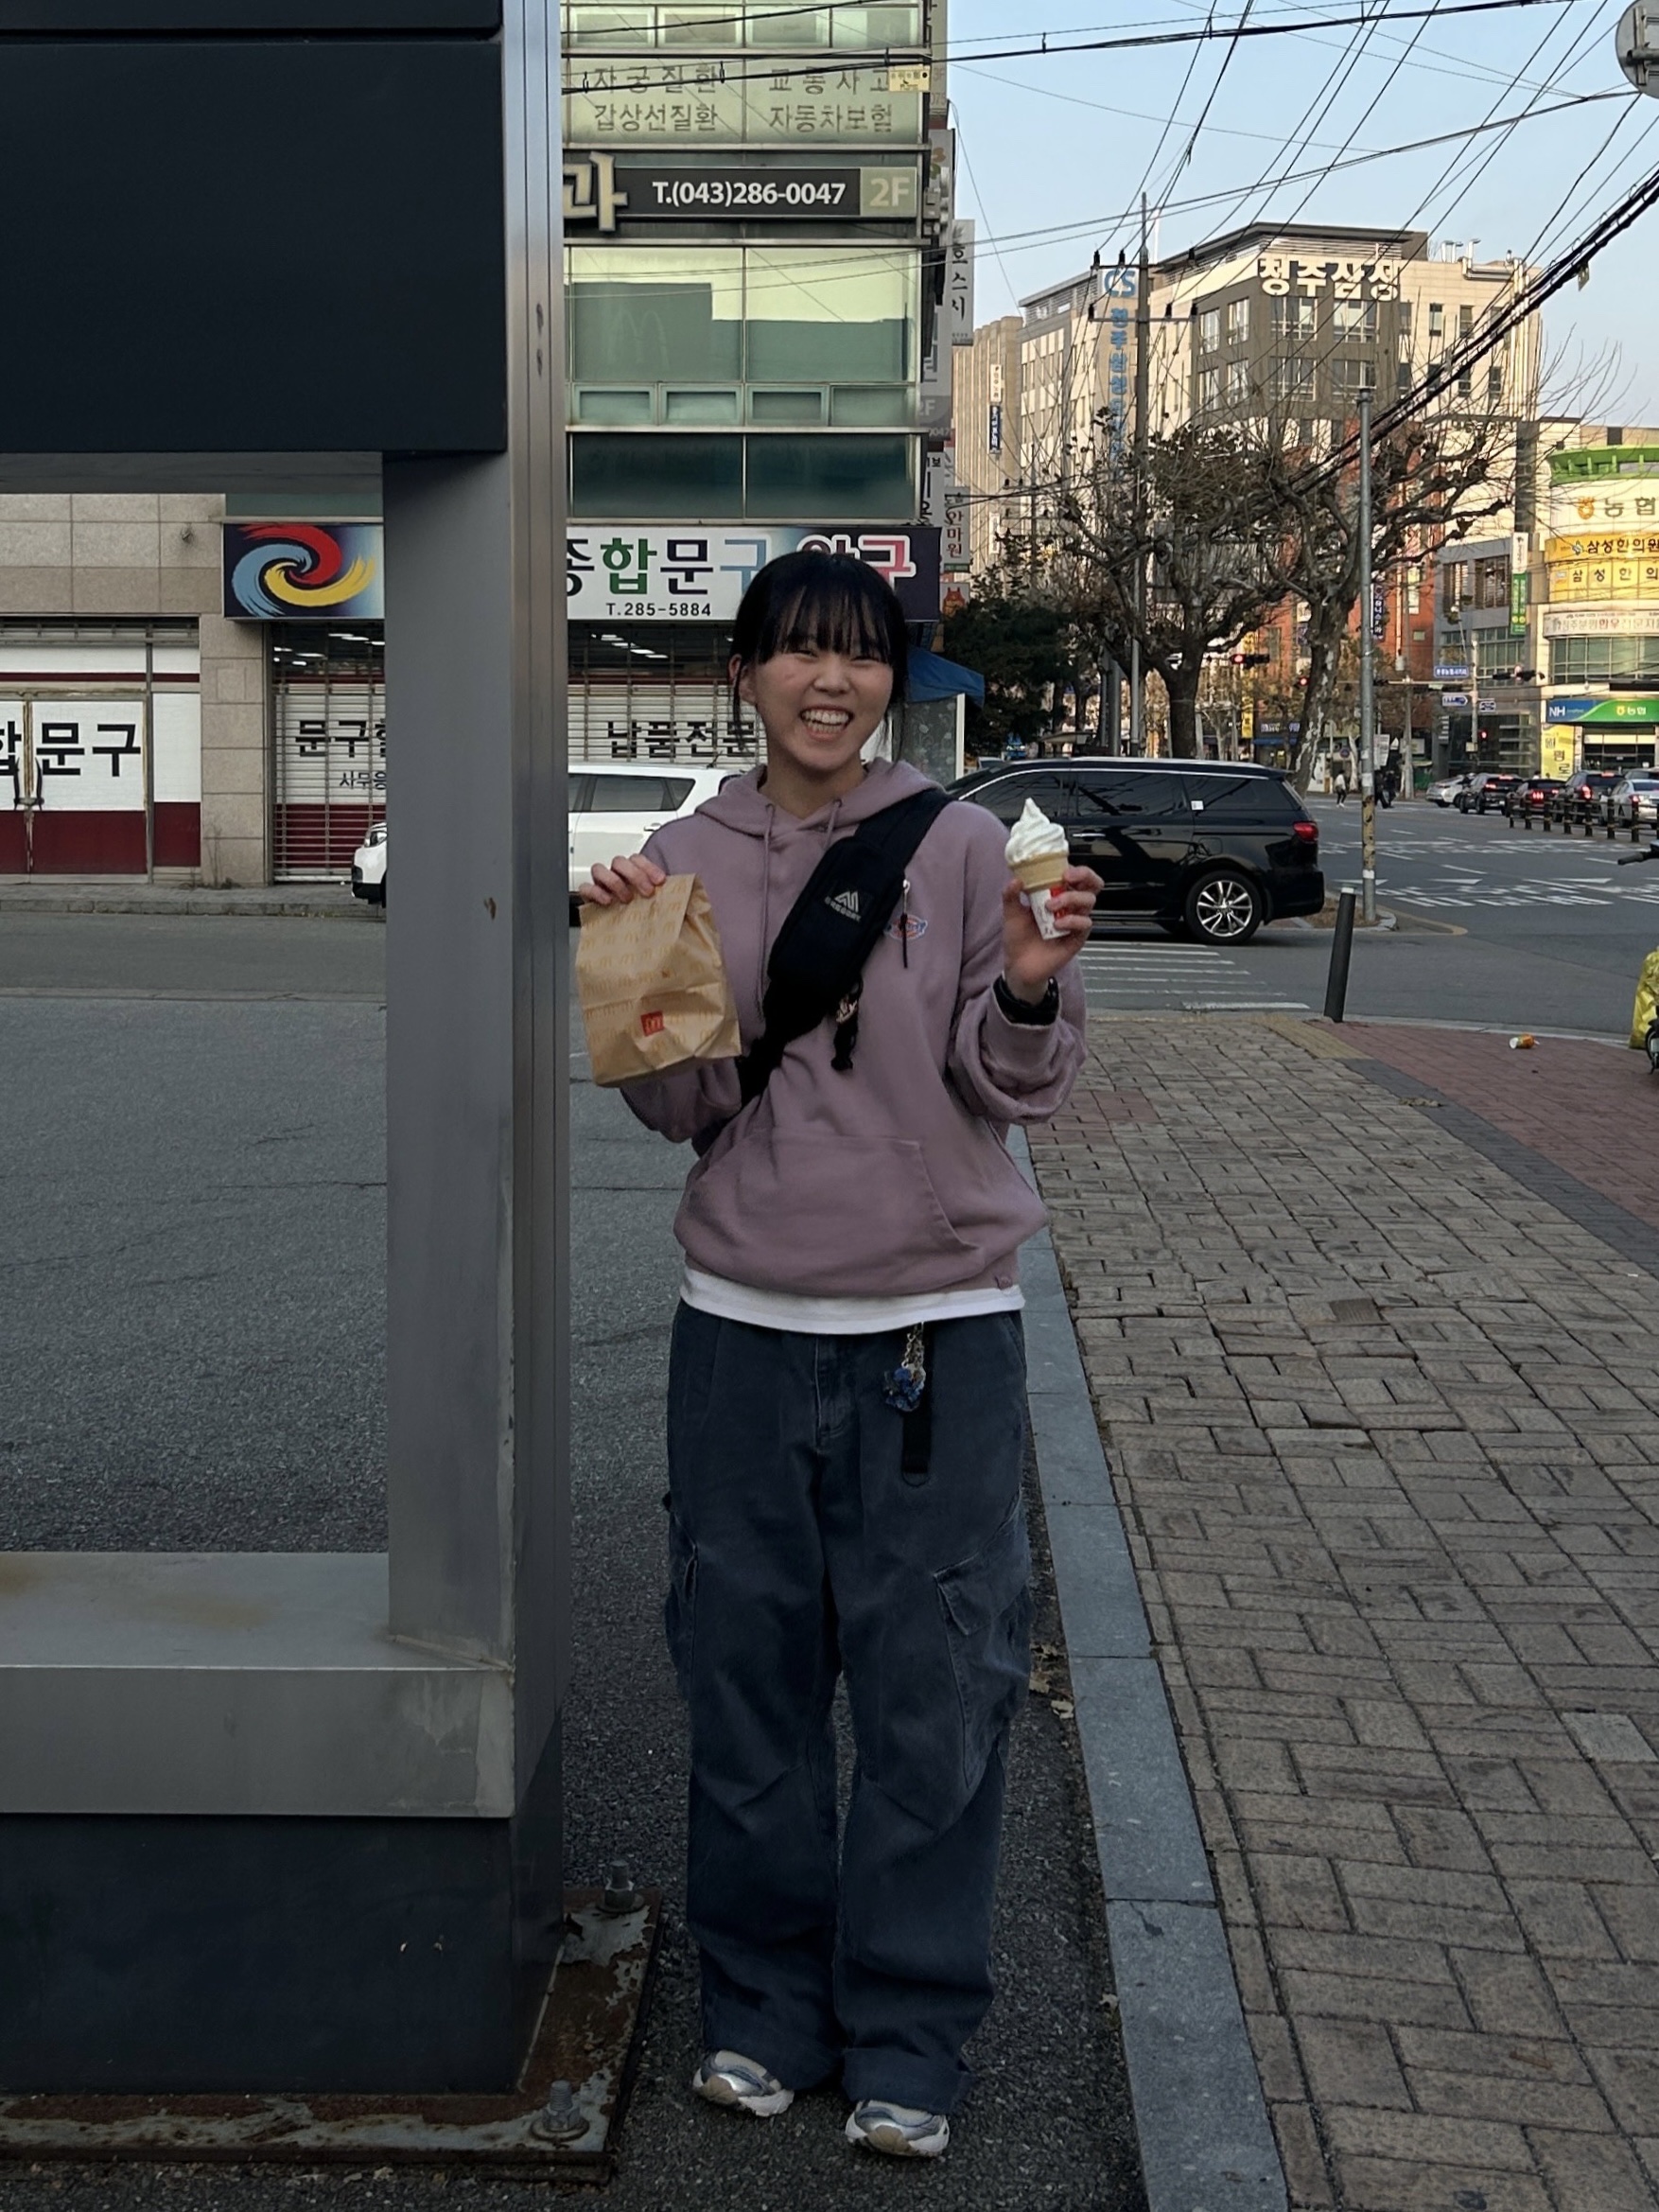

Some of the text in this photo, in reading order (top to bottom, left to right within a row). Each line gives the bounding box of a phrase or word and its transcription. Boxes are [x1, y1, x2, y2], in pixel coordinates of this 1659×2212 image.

[594, 63, 717, 94] 자궁질환
[594, 103, 718, 132] 갑상선질환
[769, 104, 892, 132] 자동차보험
[653, 177, 911, 207] T.(043)286-0047 2F
[1604, 497, 1656, 518] 농협
[606, 602, 711, 617] T.285-5884
[1549, 706, 1566, 717] NH
[295, 719, 386, 758] 문구
